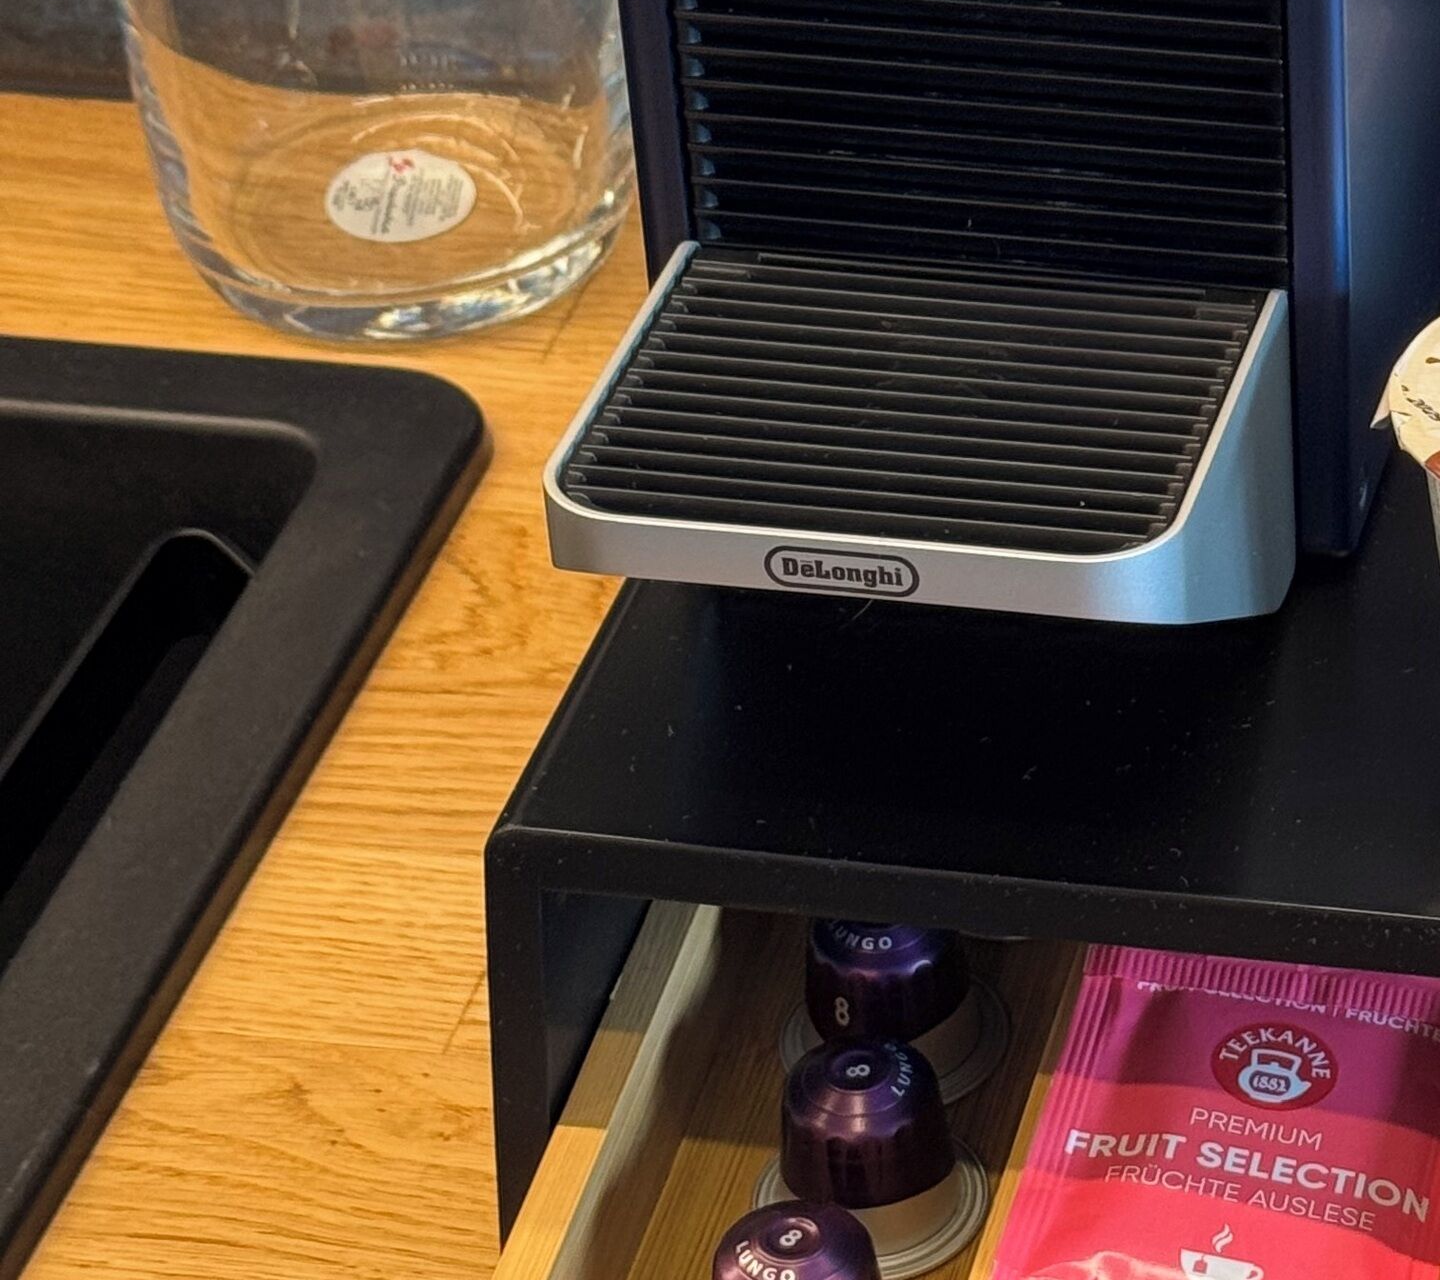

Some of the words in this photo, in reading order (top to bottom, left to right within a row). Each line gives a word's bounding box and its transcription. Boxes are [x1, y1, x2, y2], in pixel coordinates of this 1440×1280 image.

[834, 996, 851, 1027] 8
[845, 1064, 871, 1078] 8
[1219, 1027, 1331, 1079] TEEKANNE
[1187, 1106, 1325, 1153] PREMIUM
[1063, 1127, 1187, 1161] FRUIT
[1195, 1137, 1431, 1224] SELECTION
[1103, 1162, 1242, 1205] FRÜCHTE
[1249, 1187, 1377, 1234] AUSLESE
[778, 1226, 803, 1250] 8
